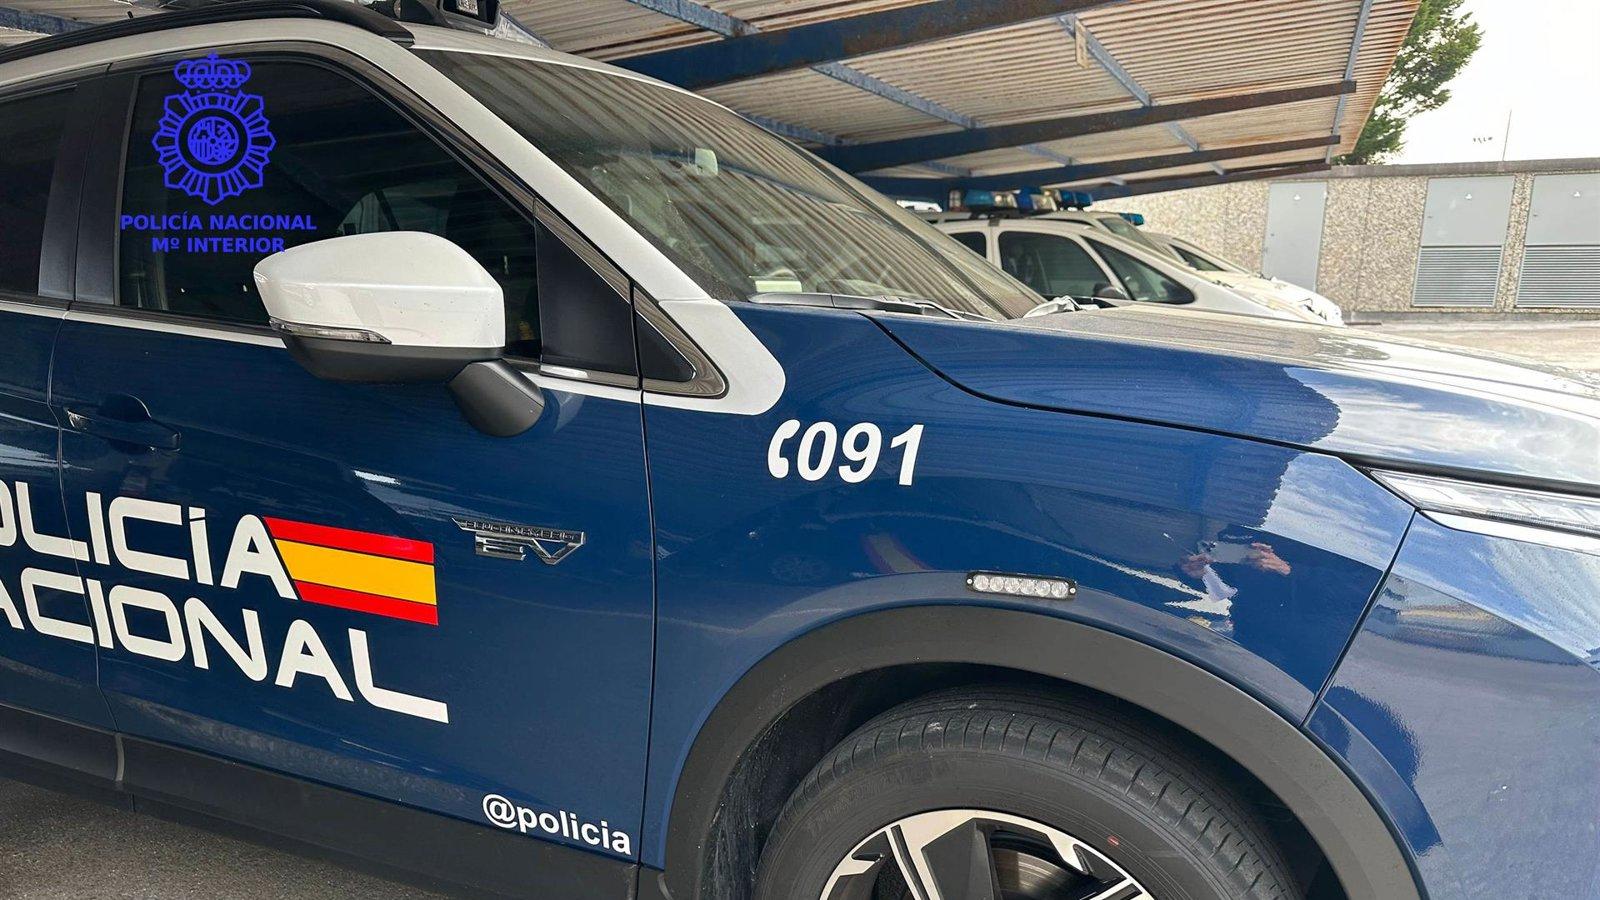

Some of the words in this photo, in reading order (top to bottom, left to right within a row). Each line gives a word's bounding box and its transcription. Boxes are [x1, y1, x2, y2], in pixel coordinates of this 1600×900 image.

[796, 420, 925, 486] 091
[0, 480, 299, 600] LICÍA
[482, 793, 632, 856] @policia
